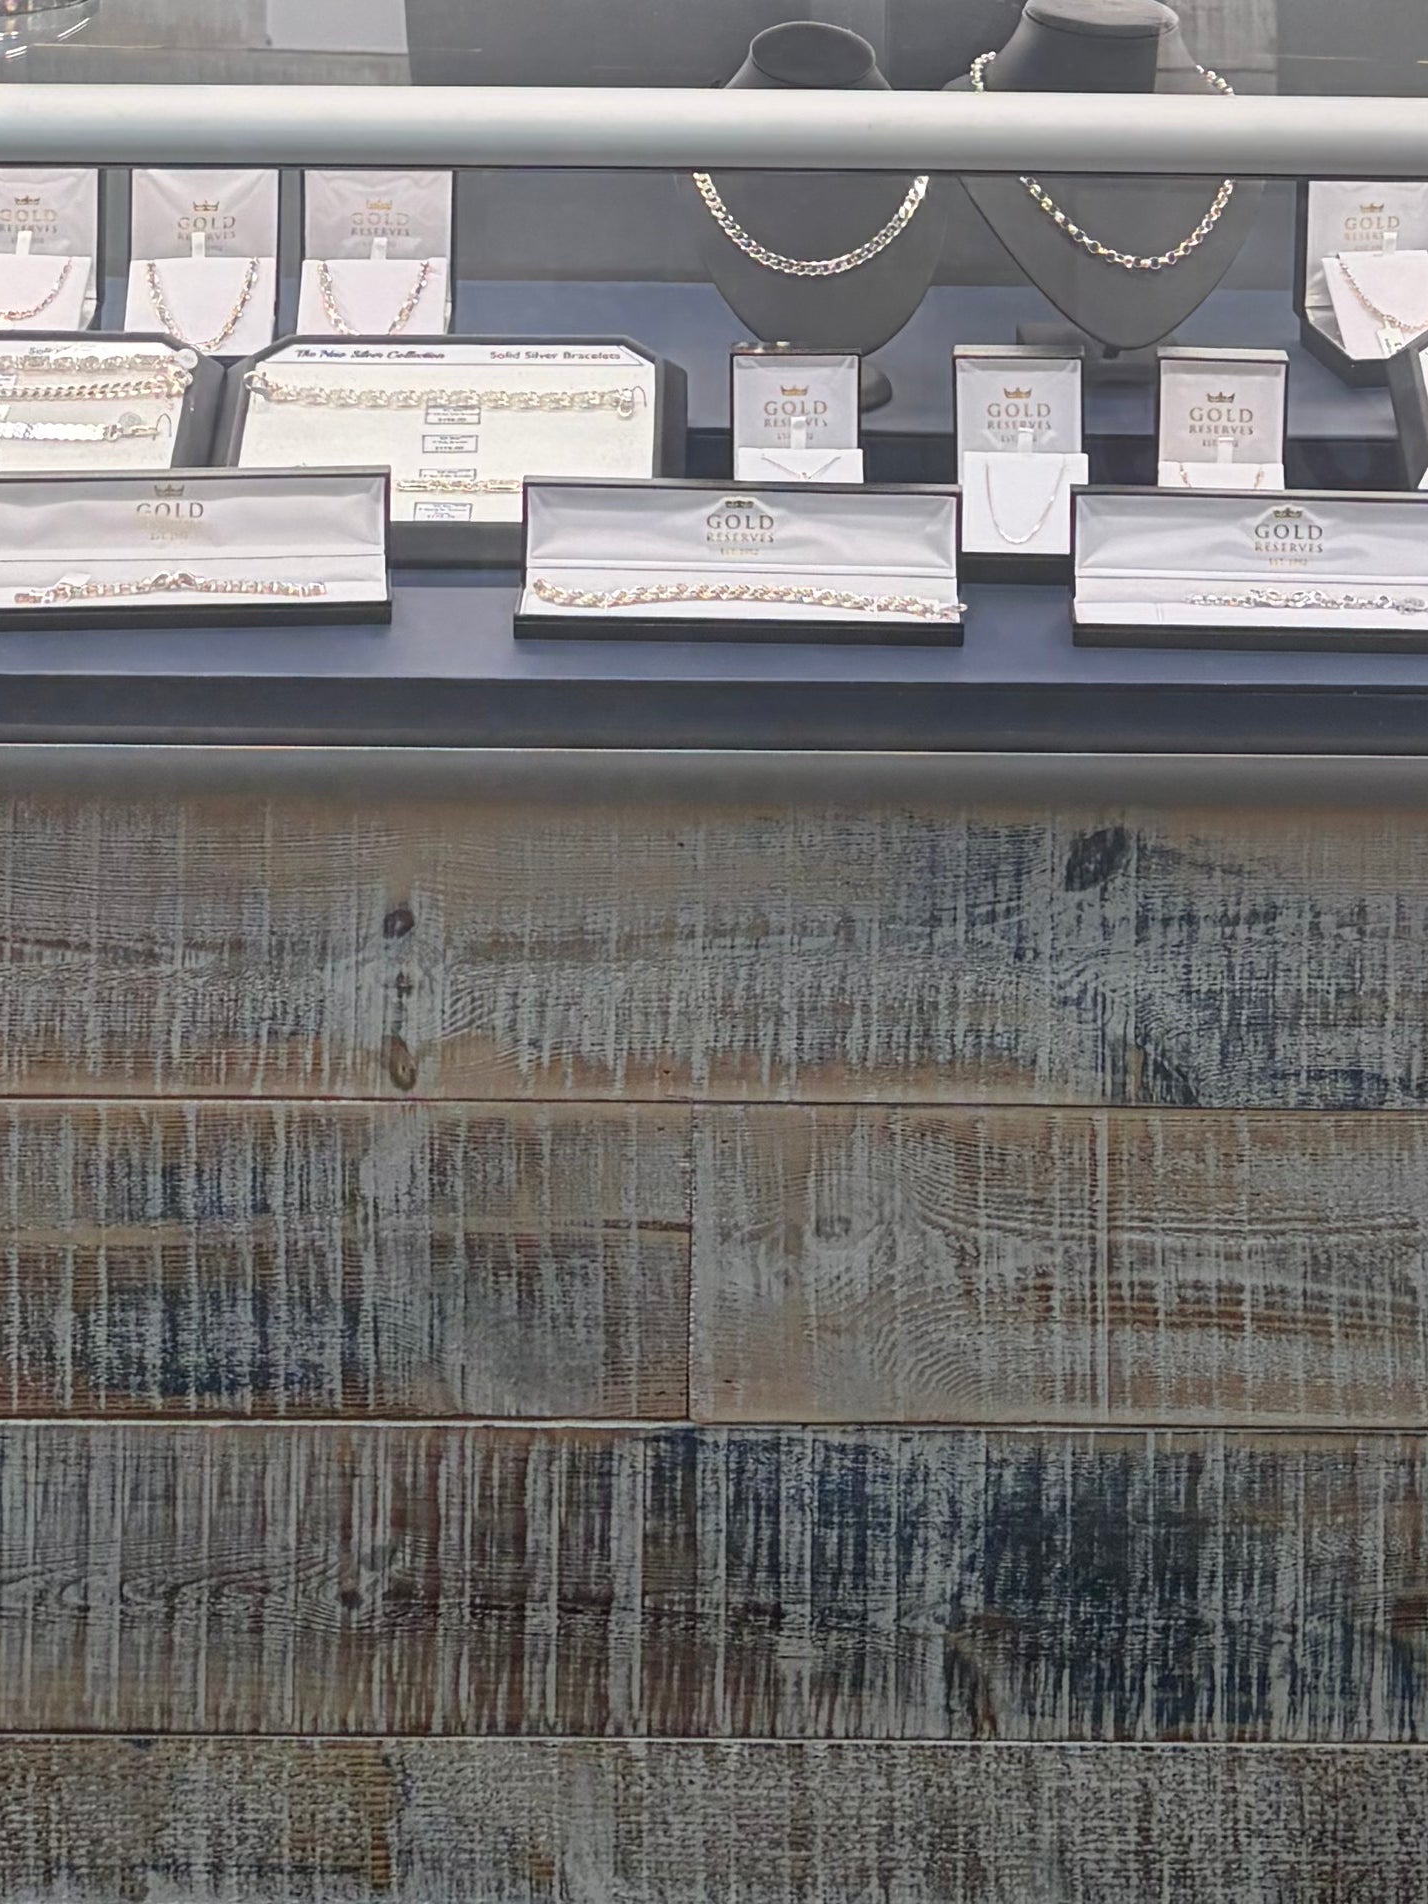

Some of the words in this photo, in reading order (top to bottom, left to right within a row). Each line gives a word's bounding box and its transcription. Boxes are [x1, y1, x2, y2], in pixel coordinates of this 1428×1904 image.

[178, 216, 236, 231] GOLD
[351, 213, 409, 226] GOLD
[1344, 216, 1400, 230] GOLD
[764, 401, 828, 415] GOLD
[987, 403, 1051, 417] GOLD
[1189, 407, 1253, 422] GOLD
[1189, 424, 1254, 435] RESERVES
[137, 502, 204, 519] GOLD
[707, 514, 774, 530] GOLD
[707, 532, 774, 543] RESERVES
[1255, 524, 1322, 540] GOLD
[1255, 542, 1323, 553] RESERVES
